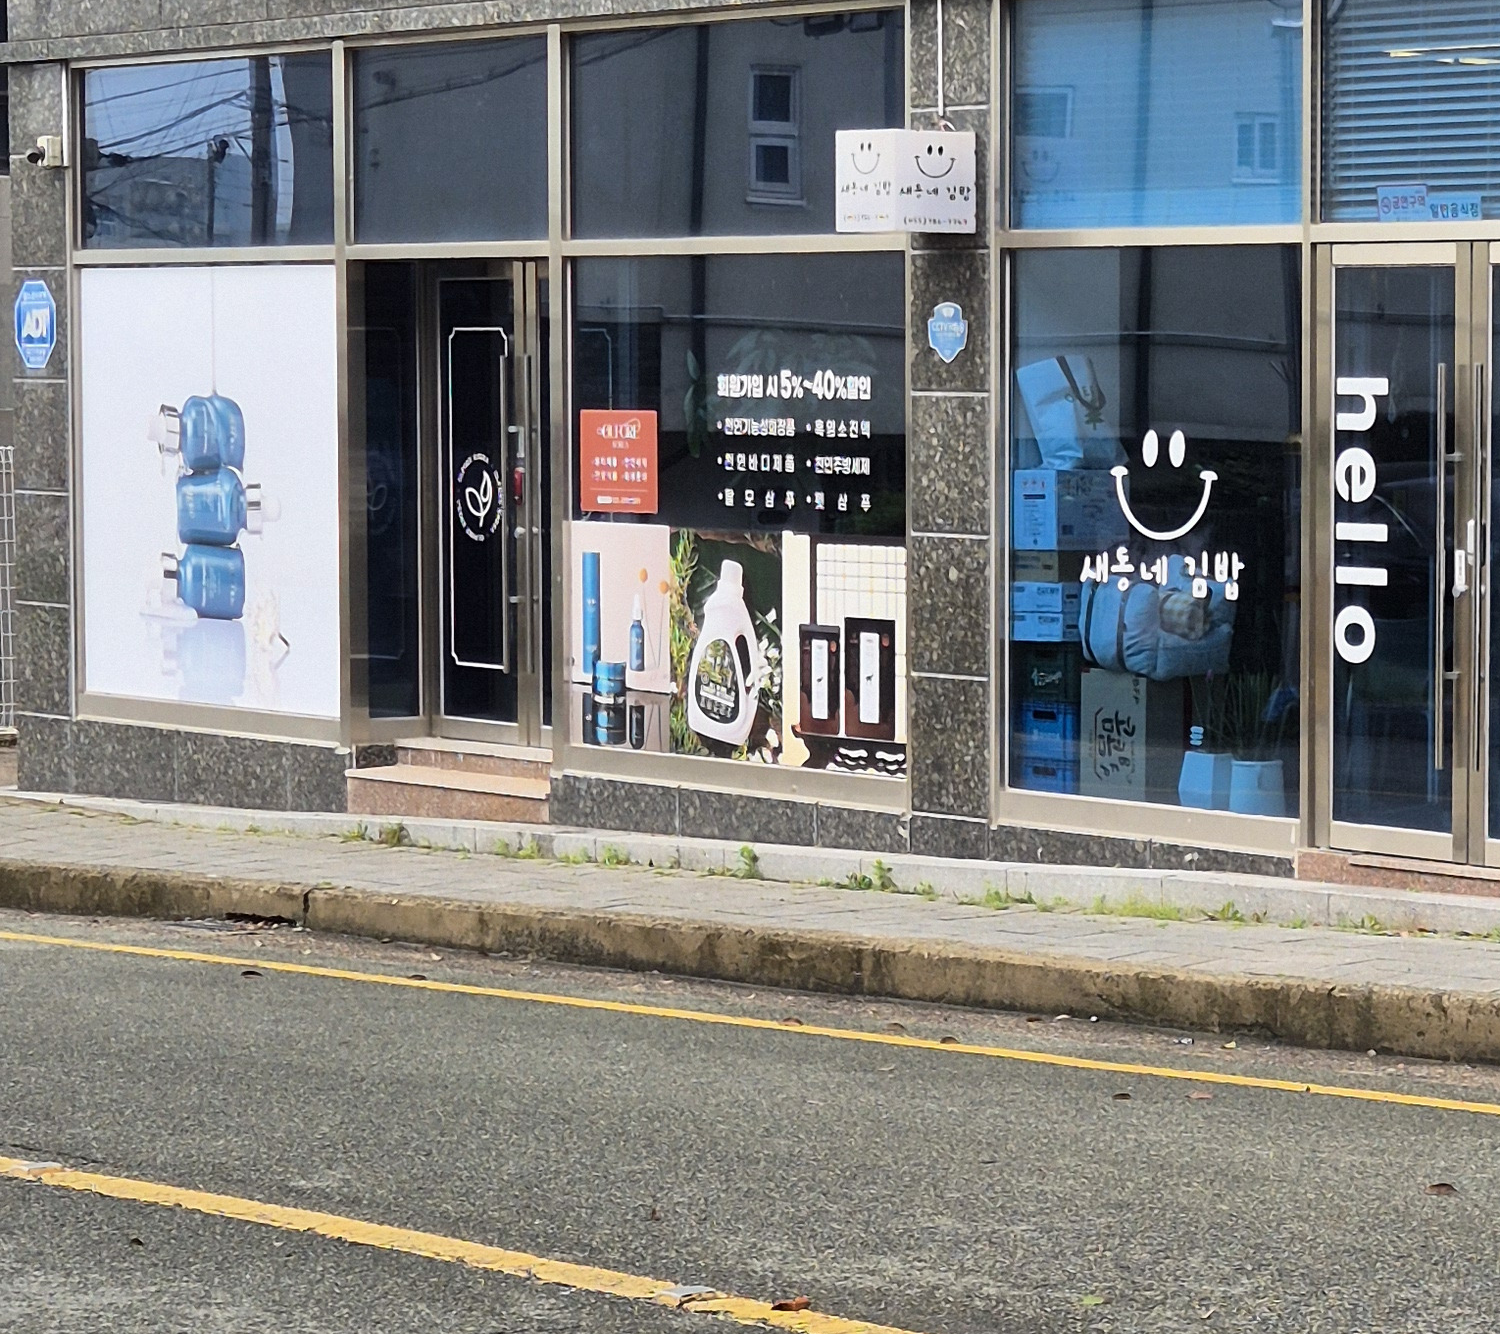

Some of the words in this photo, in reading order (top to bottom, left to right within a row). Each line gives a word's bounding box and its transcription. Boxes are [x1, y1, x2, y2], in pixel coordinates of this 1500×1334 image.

[23, 307, 49, 339] ADT
[717, 374, 763, 398] 회원가입
[766, 375, 778, 398] 시
[1335, 377, 1389, 664] hello
[1080, 546, 1168, 591] 새동네
[1184, 550, 1245, 600] 김밥
